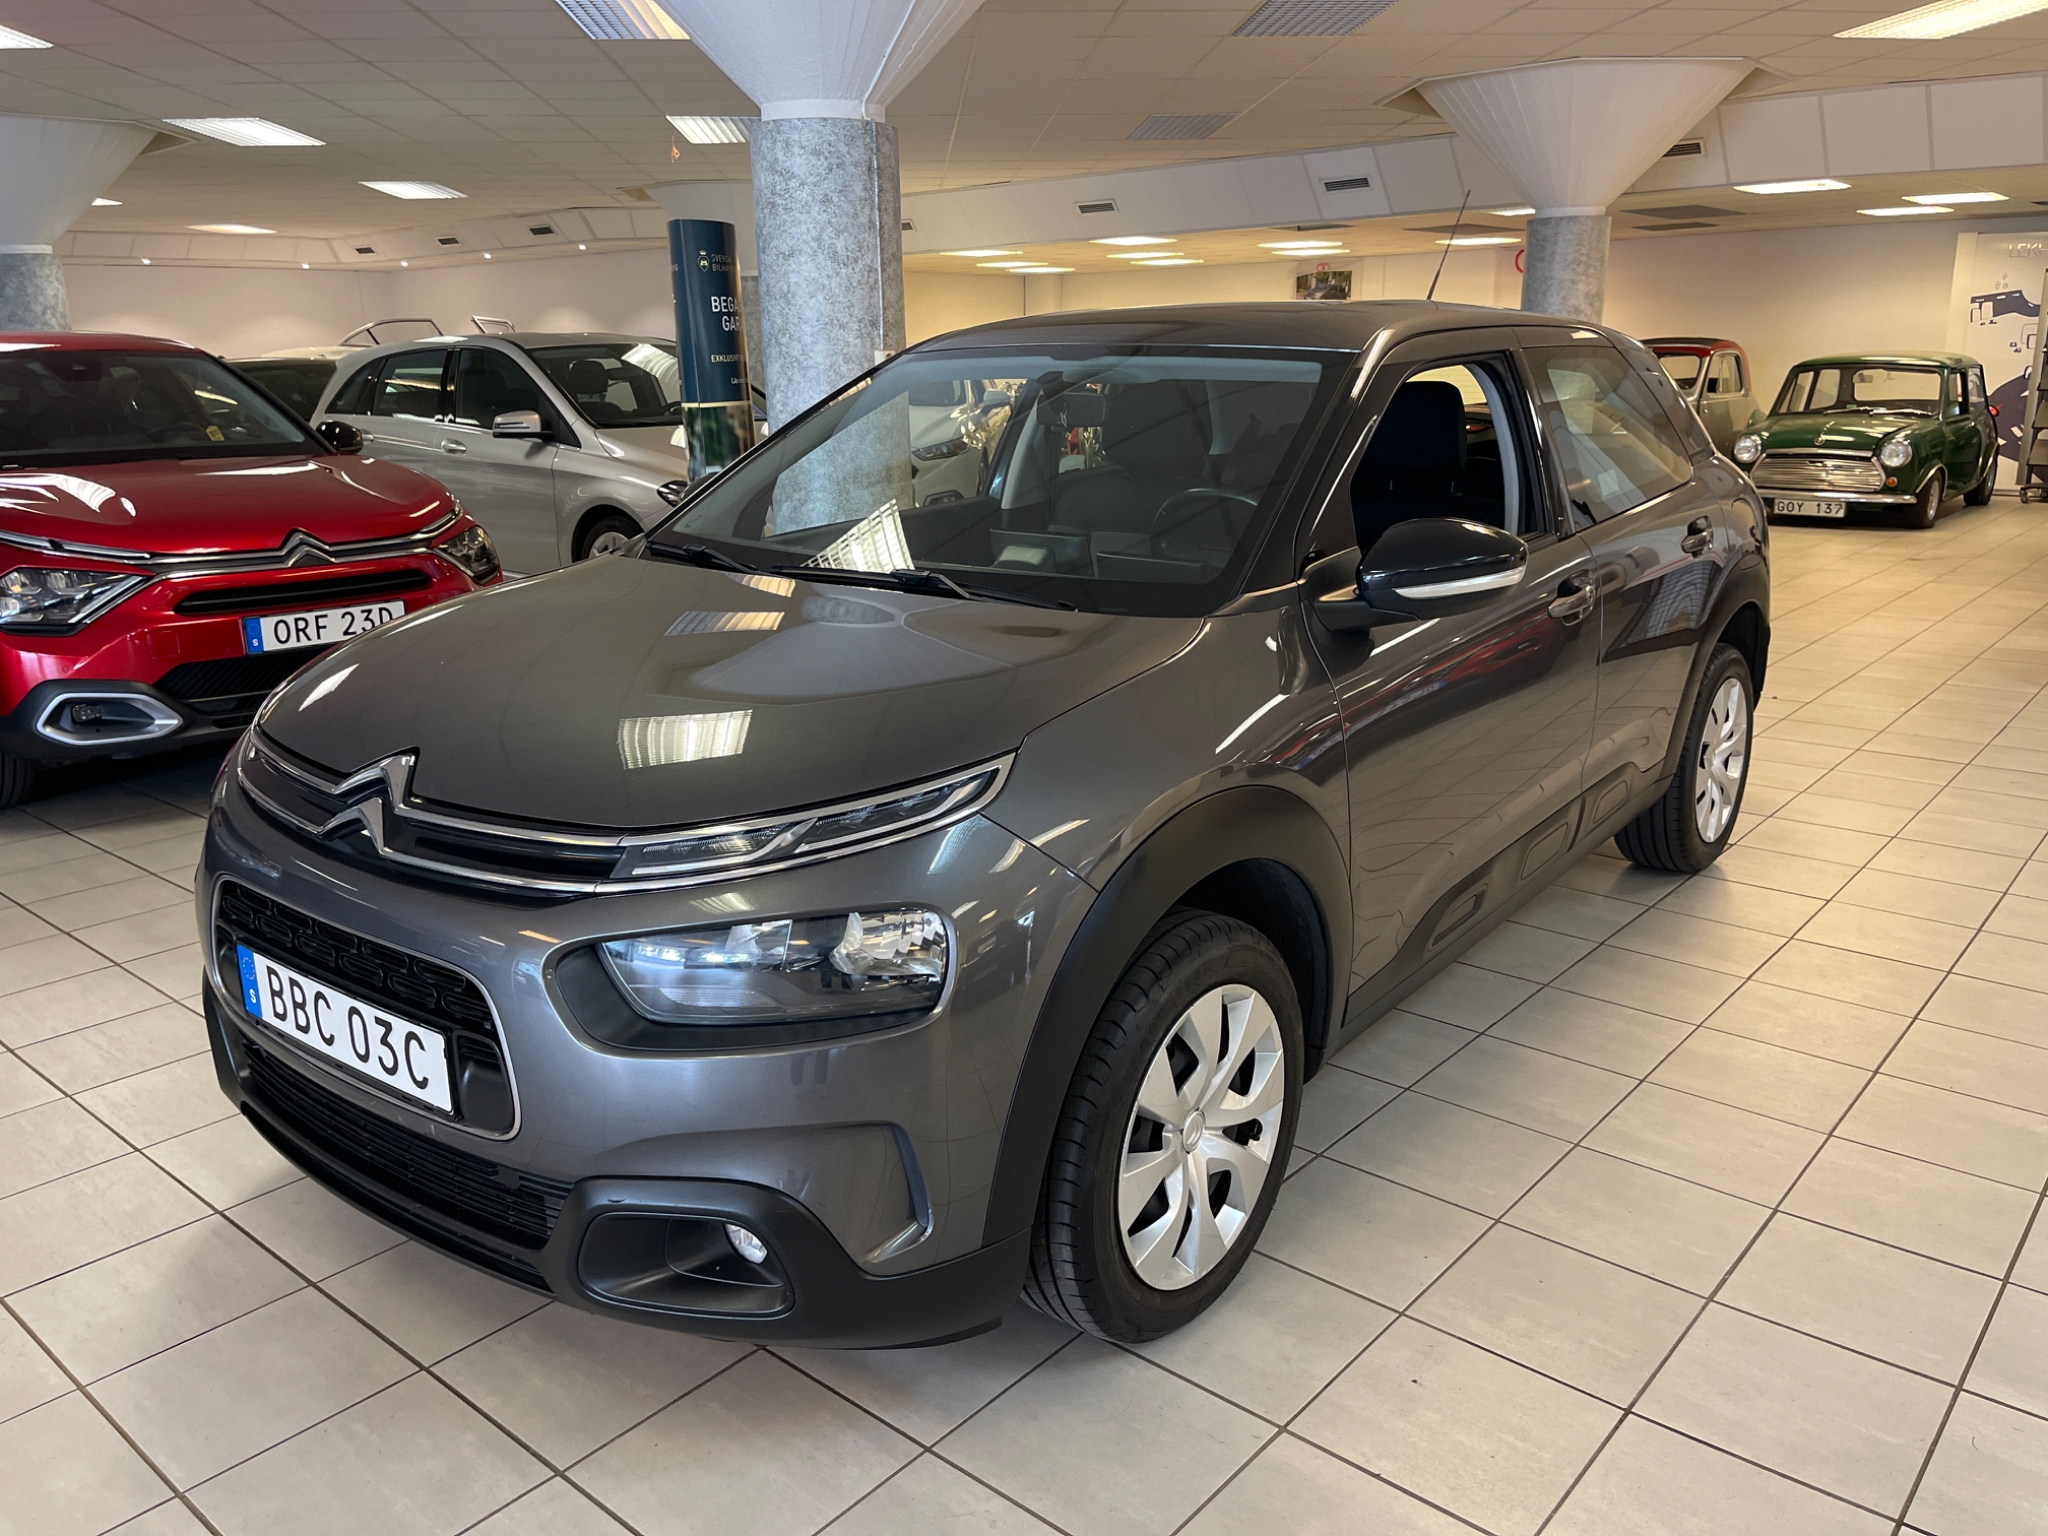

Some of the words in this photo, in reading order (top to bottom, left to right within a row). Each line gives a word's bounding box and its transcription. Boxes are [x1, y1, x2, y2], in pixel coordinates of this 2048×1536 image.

[722, 316, 743, 331] GAR
[1777, 501, 1804, 513] GOY
[1816, 503, 1843, 515] 137
[252, 639, 259, 647] S
[273, 614, 329, 645] ORF
[341, 607, 394, 637] 23D
[249, 988, 257, 1004] S
[265, 964, 336, 1047] BBC
[347, 1005, 430, 1091] 03C
